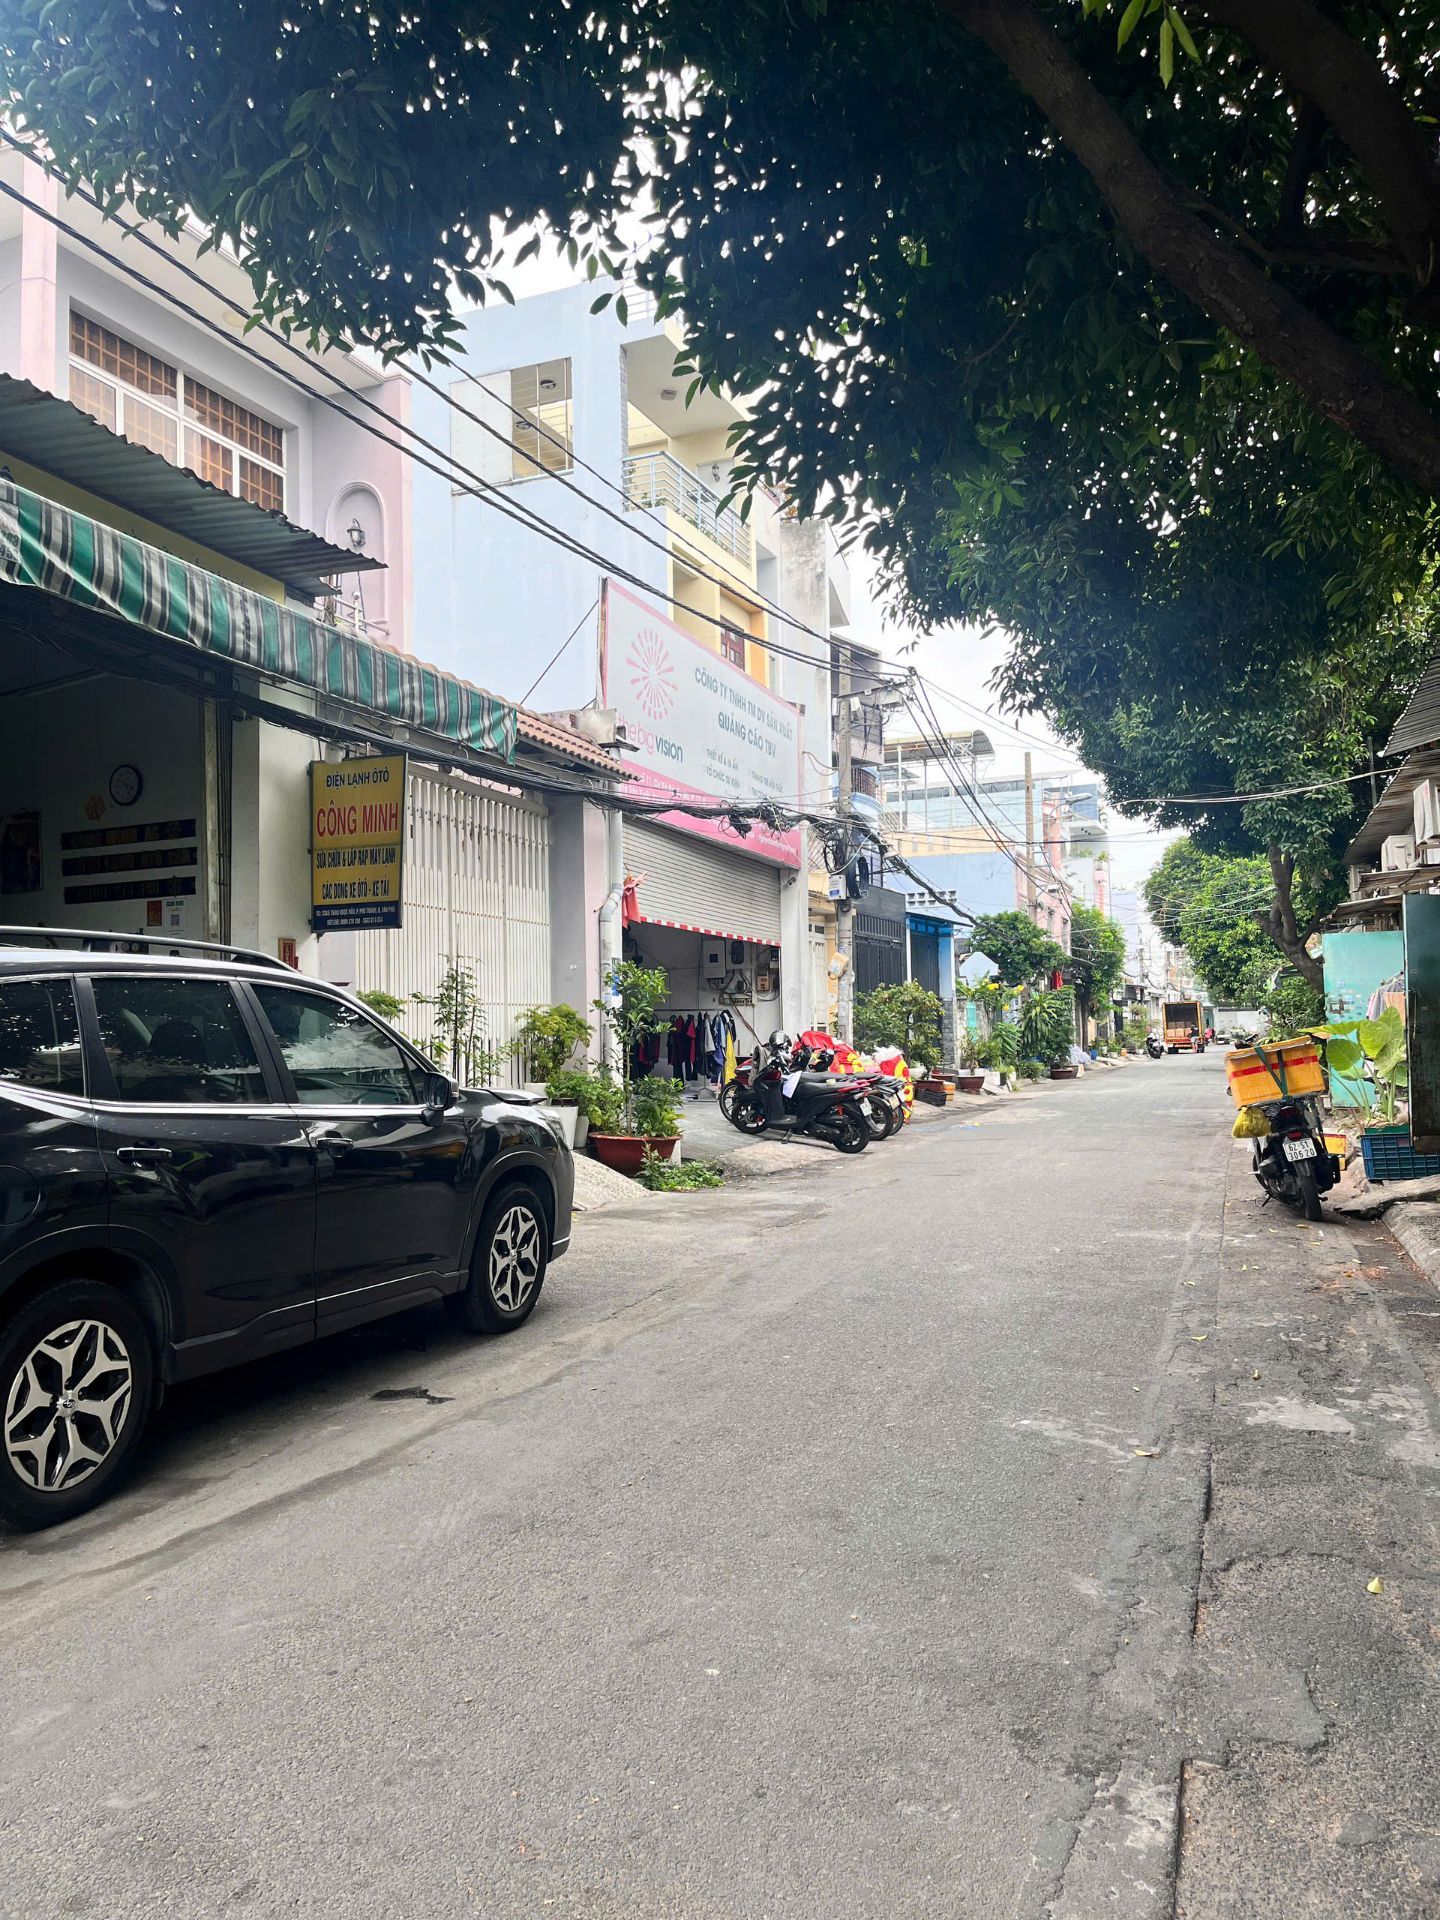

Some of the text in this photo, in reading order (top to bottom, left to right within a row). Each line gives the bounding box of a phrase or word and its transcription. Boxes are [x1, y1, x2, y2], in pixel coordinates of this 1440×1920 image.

[695, 667, 719, 694] CÔNG
[720, 681, 728, 700] TY
[718, 711, 746, 741] QUẢNG
[748, 727, 764, 751] CÁO
[326, 771, 345, 790] ĐIỆN
[347, 771, 370, 789] LẠNH
[317, 799, 399, 837] CÔNG MINH
[322, 880, 333, 900] CÁC
[349, 881, 356, 898] XE
[372, 880, 379, 897] XE
